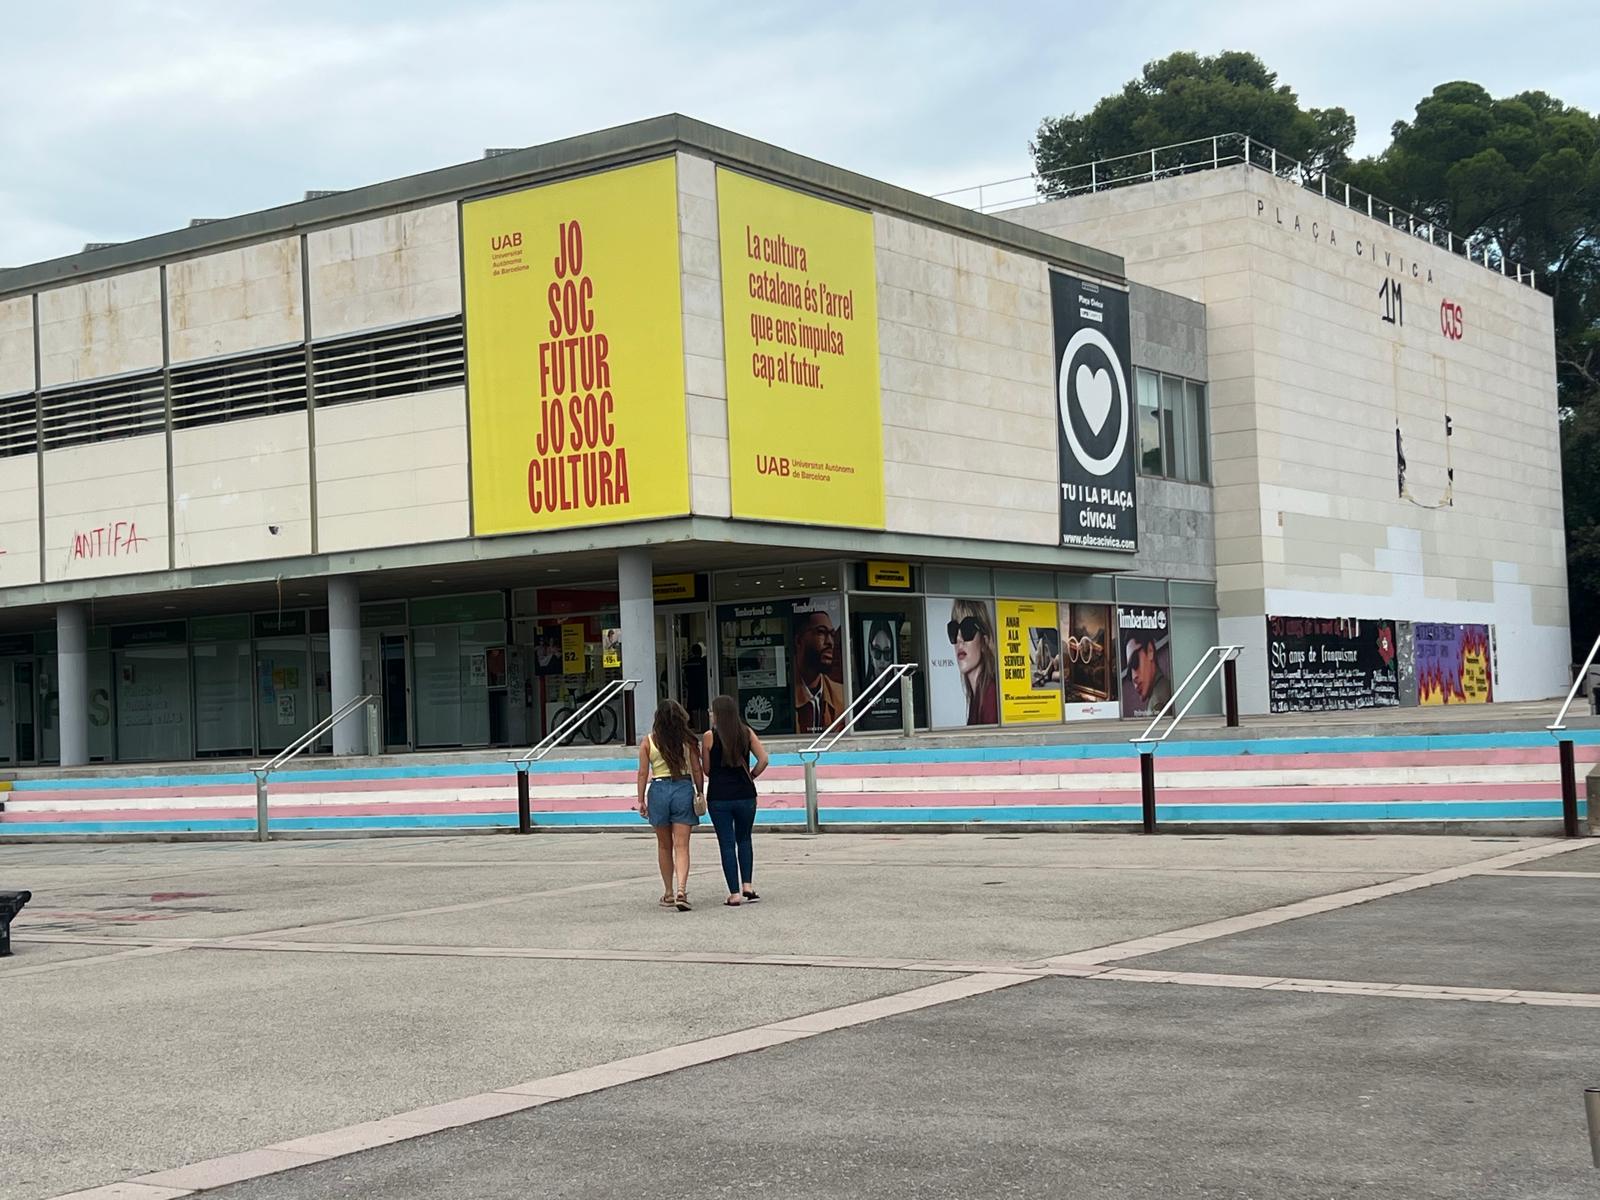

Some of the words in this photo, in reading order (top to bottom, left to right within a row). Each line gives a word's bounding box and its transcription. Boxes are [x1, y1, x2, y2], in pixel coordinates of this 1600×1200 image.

[1257, 199, 1337, 246] PLAÇA
[491, 232, 523, 251] UAB
[554, 219, 583, 280] JO
[746, 225, 761, 261] La
[763, 234, 807, 273] cultura
[492, 249, 523, 260] Universitat
[501, 265, 530, 275] Barcelona
[748, 270, 801, 310] catalana
[804, 280, 818, 314] és
[548, 276, 594, 339] SOC
[750, 312, 773, 346] que
[776, 318, 797, 347] ens
[798, 316, 844, 358] impulsa
[538, 333, 611, 398] FUTUR
[752, 352, 775, 388] cap
[777, 351, 788, 384] al
[790, 352, 824, 390] futur.
[536, 398, 565, 456] JO
[568, 390, 615, 452] SOC
[756, 454, 790, 477] UAB
[791, 458, 824, 471] Universitat
[825, 463, 855, 474] Autònoma
[792, 470, 800, 478] de
[801, 471, 831, 482] Barcelona
[528, 447, 630, 514] CULTURA
[1061, 482, 1076, 501] TU
[1078, 485, 1083, 502] I
[1084, 486, 1099, 504] LA
[1100, 488, 1134, 512] PLAÇA
[1079, 507, 1116, 530] CÍVICA!
[1006, 616, 1020, 628] ANAR
[1117, 607, 1158, 629] Timberland
[1008, 630, 1013, 640] A
[1013, 630, 1019, 641] LA
[1004, 656, 1026, 667] SERVEIX
[1288, 650, 1306, 669] anys
[1308, 645, 1317, 663] de
[1321, 644, 1358, 668] franquisme
[1005, 668, 1012, 679] DE
[1012, 668, 1026, 679] MOLT
